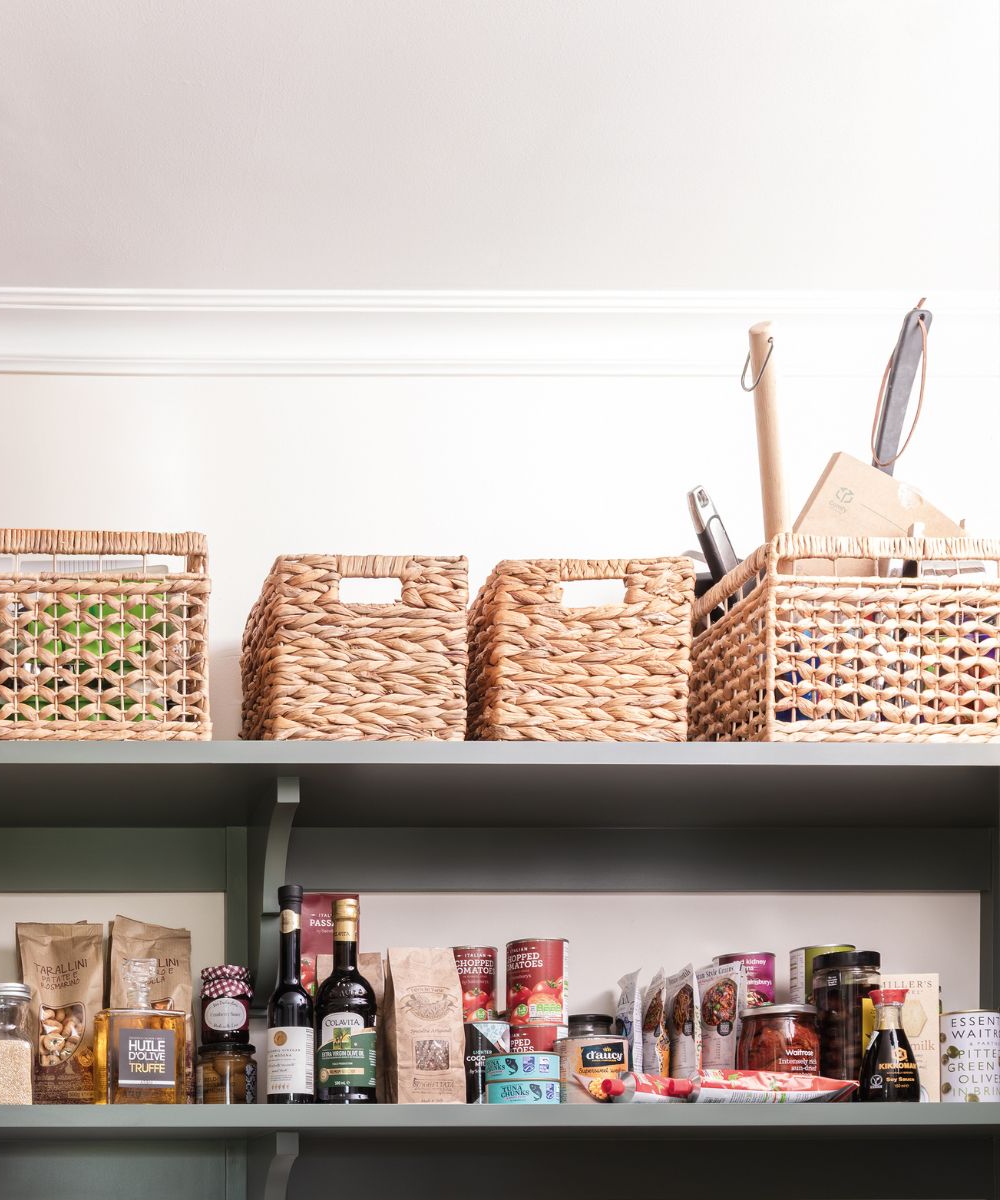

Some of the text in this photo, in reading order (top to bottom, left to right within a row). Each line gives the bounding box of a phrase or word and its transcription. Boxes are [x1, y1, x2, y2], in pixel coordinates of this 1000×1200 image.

[33, 958, 88, 975] TARALLINI
[455, 959, 494, 968] CHOPPED
[745, 957, 767, 967] kidney
[457, 966, 496, 975] OMATOES
[325, 1018, 361, 1028] COLAVITA
[128, 1040, 166, 1052] HUILE
[128, 1051, 166, 1061] D'OLIVE
[586, 1050, 623, 1061] d'aucy
[958, 1048, 1000, 1060] PITTE
[778, 1058, 808, 1066] Intensely
[878, 1062, 918, 1070] KIKKOMAN
[947, 1061, 995, 1073] GREEN
[129, 1063, 166, 1074] TRUFFE
[958, 1073, 1000, 1084] OLIVE
[500, 1090, 530, 1098] CHUNKS
[502, 1085, 523, 1093] TUNA
[953, 1087, 968, 1097] IN
